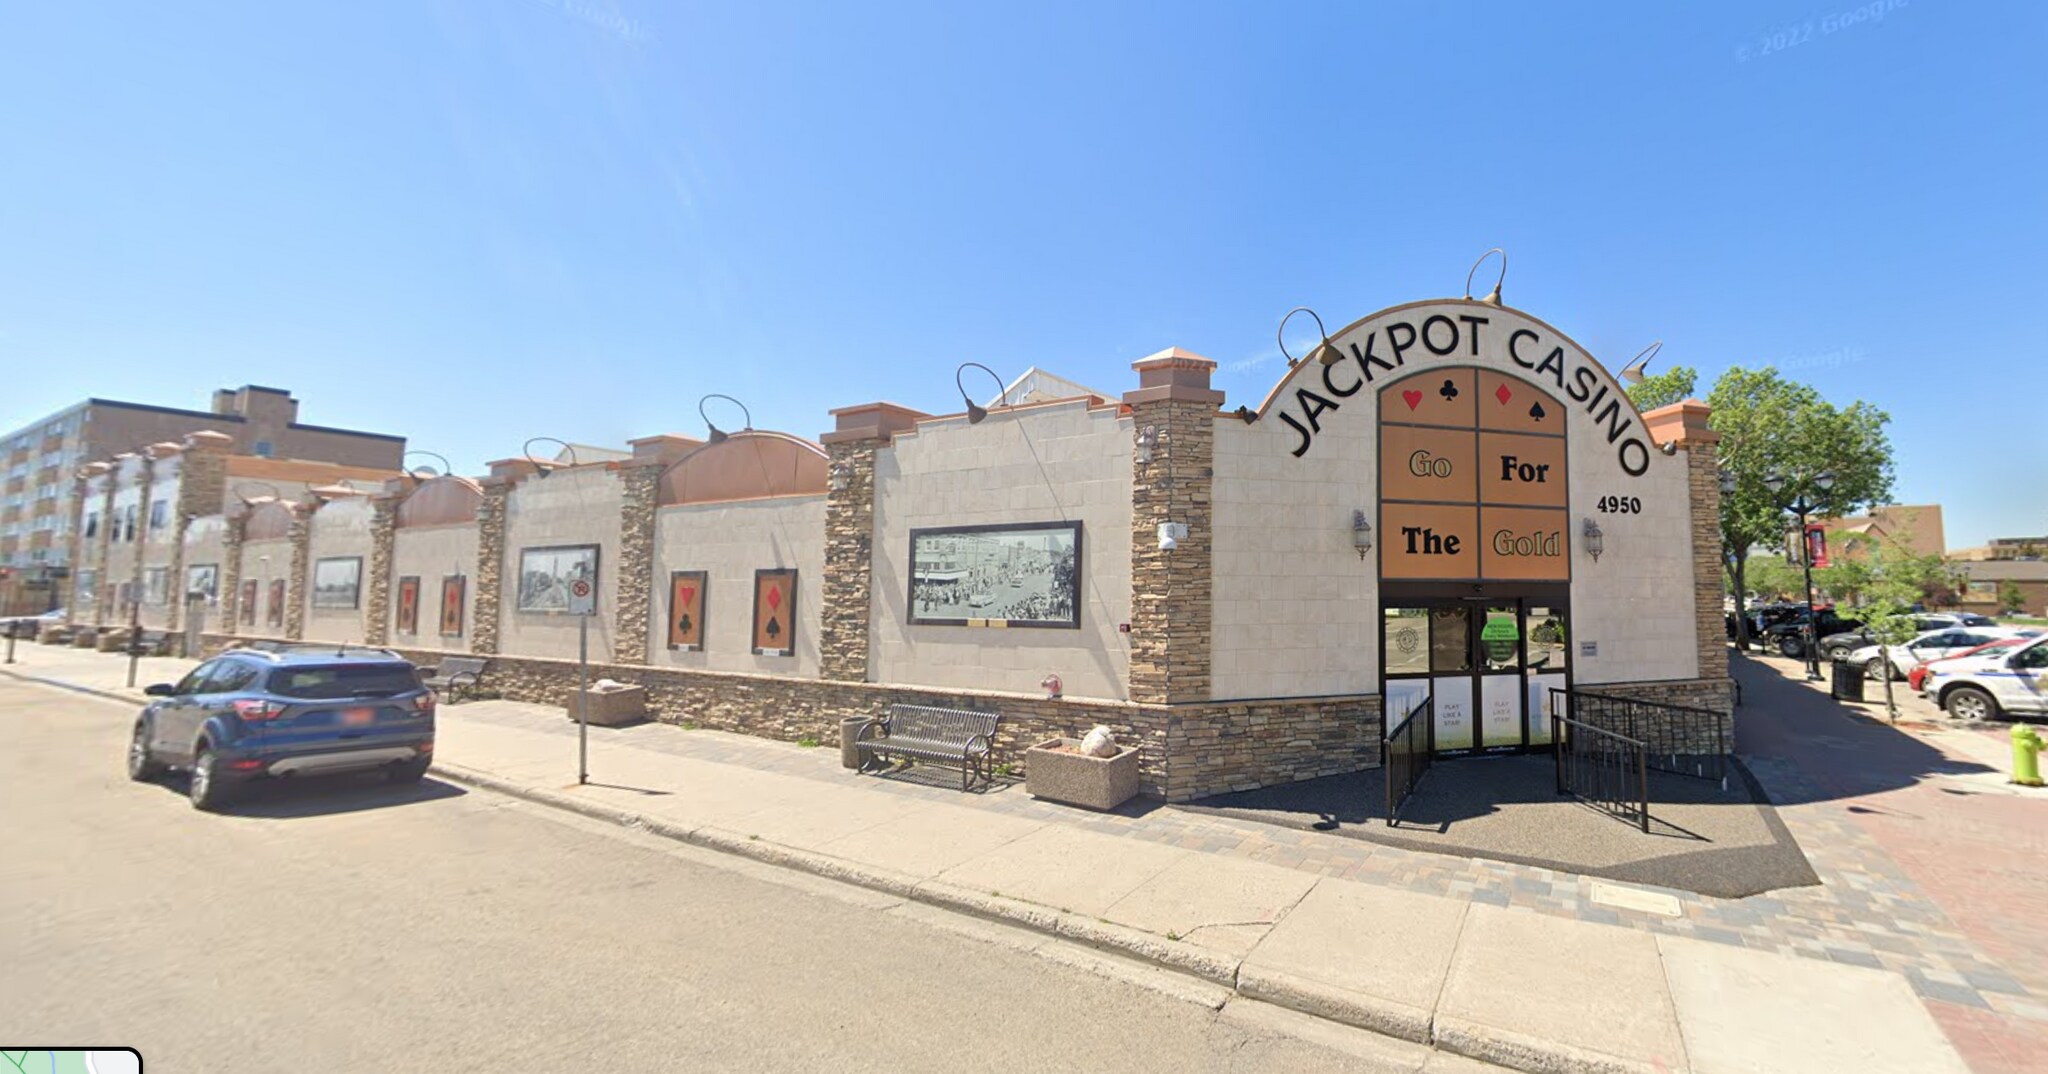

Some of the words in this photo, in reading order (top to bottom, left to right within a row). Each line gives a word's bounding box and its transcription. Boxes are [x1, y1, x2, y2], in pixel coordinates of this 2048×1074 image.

[1277, 315, 1490, 457] JACKPOT
[1509, 328, 1650, 477] CASINO
[1409, 450, 1452, 478] Go
[1501, 456, 1549, 482] For
[1597, 496, 1642, 514] 4950
[1402, 527, 1461, 555] The
[1493, 529, 1560, 556] Gold
